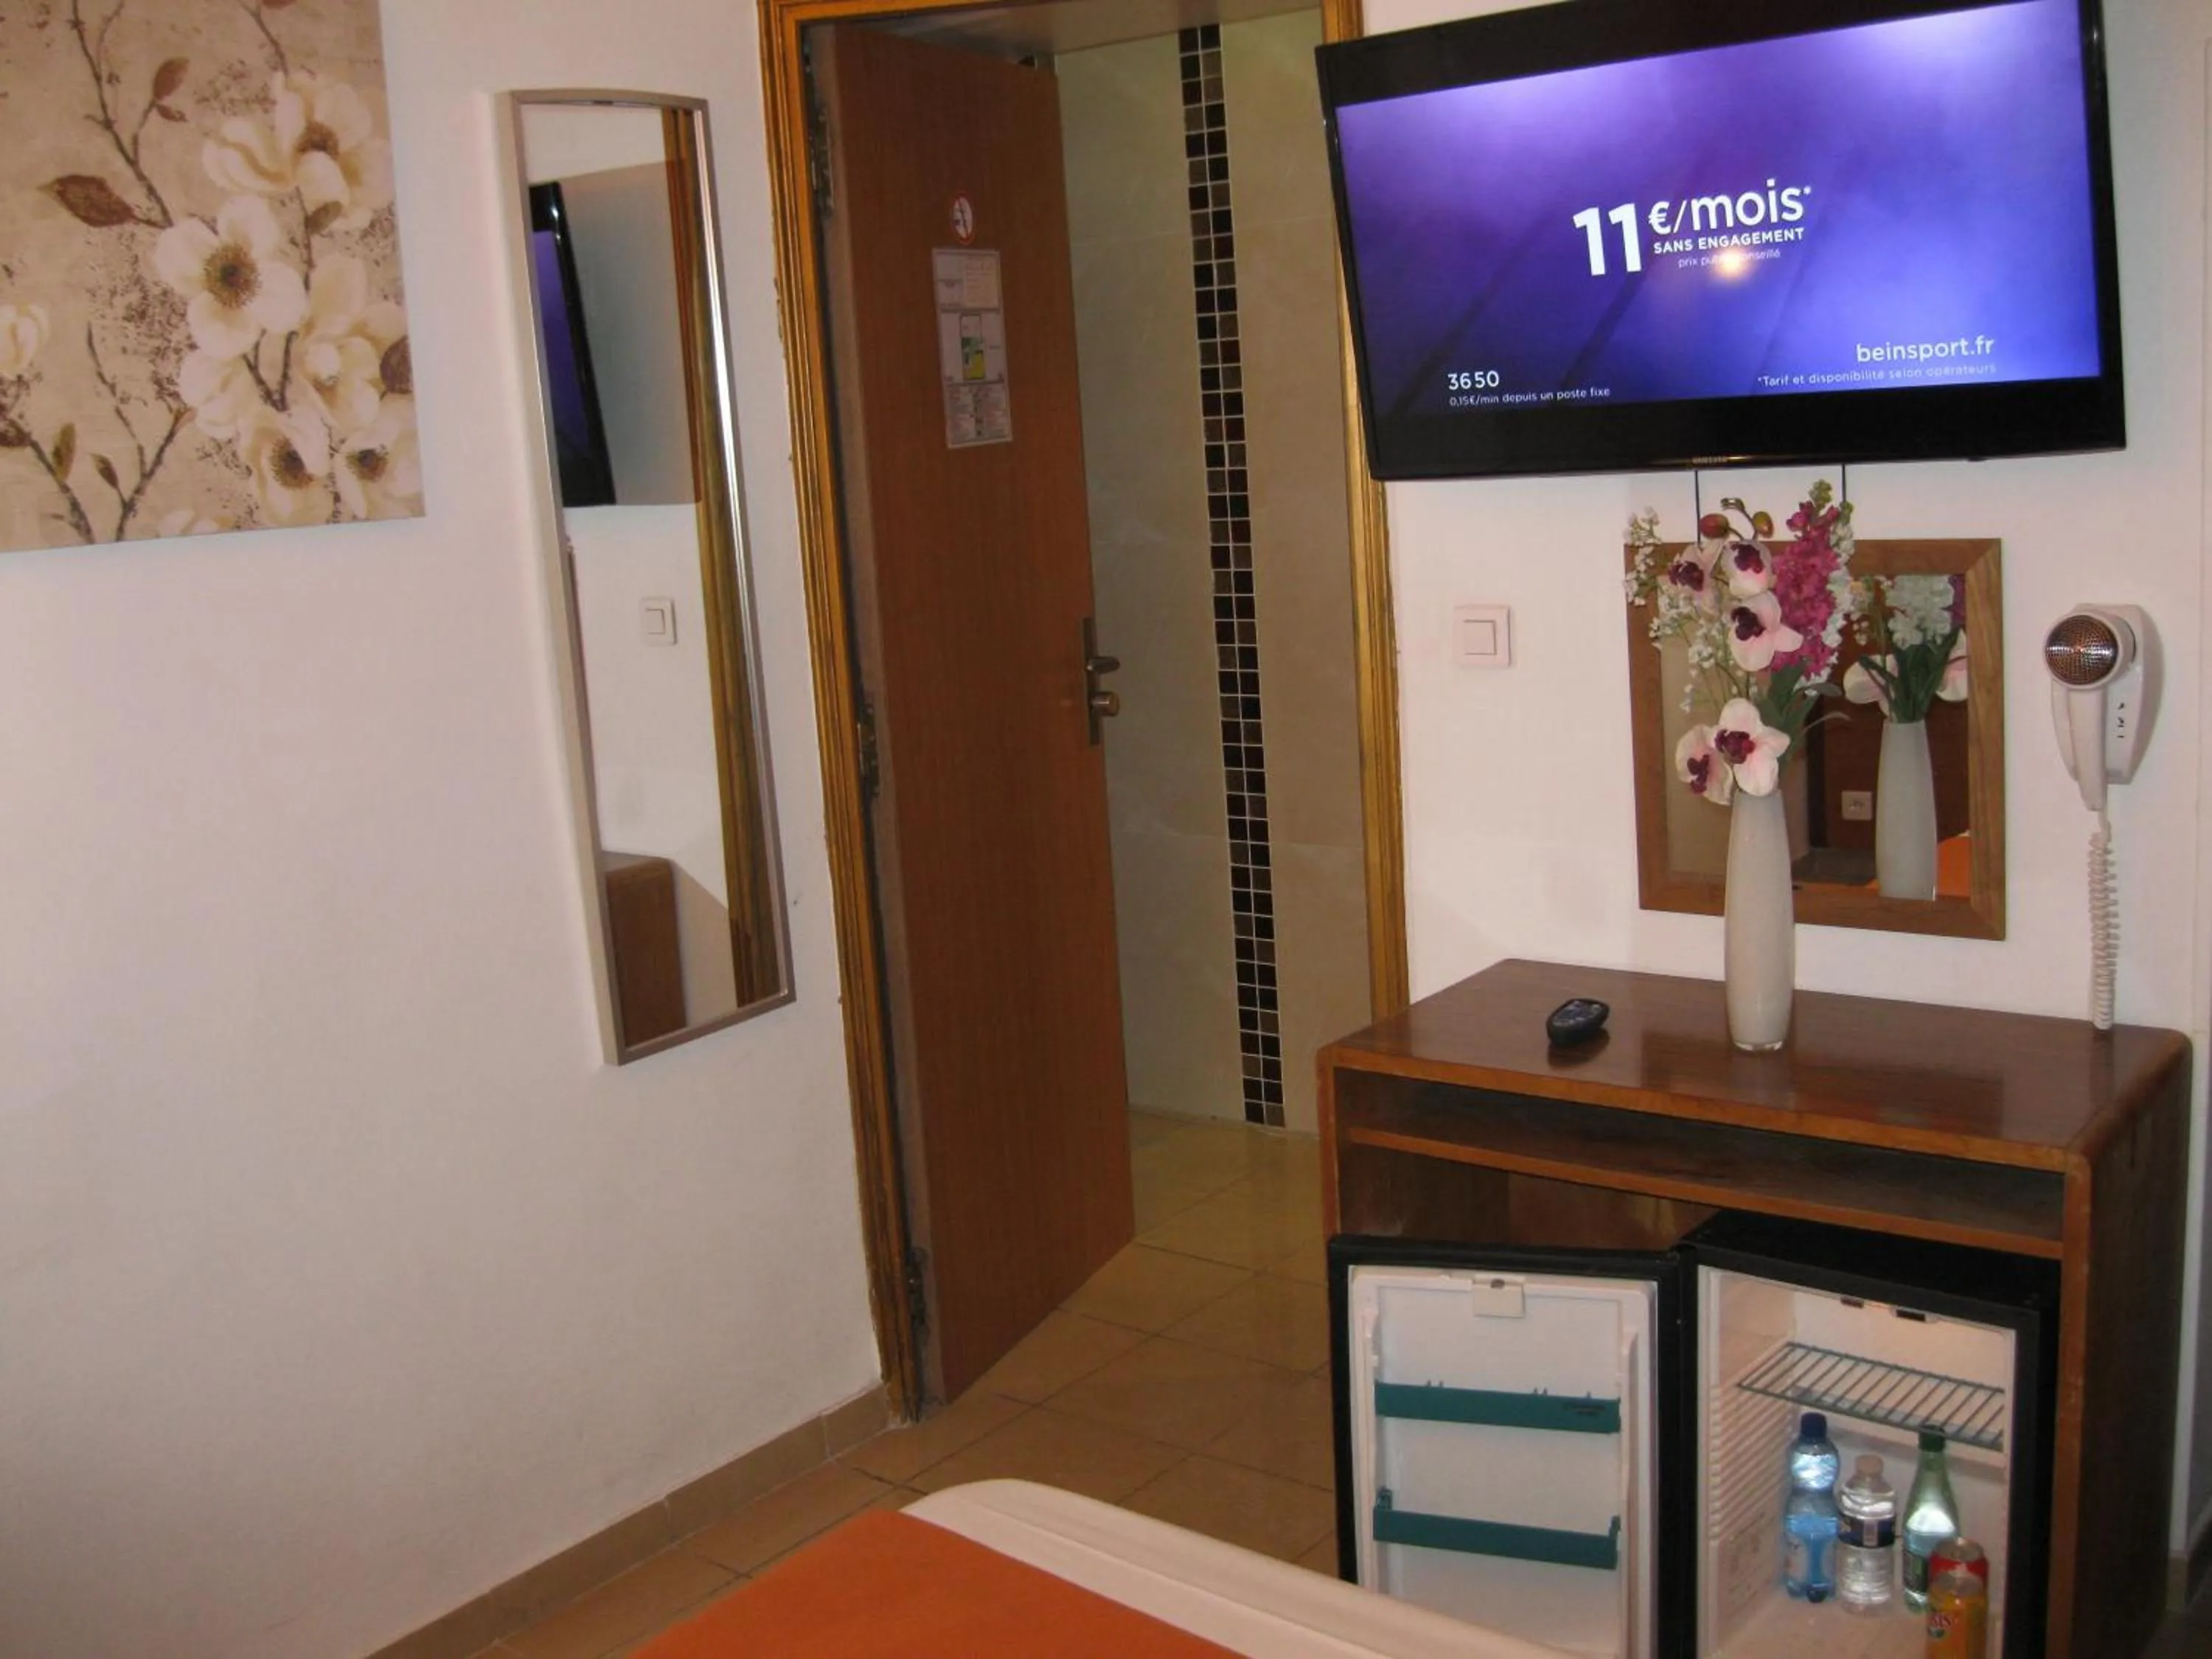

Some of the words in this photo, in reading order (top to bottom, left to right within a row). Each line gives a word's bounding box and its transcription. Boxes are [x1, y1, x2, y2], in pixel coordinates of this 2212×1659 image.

[1573, 202, 1642, 276] 11
[1653, 238, 1693, 254] SANS
[1698, 227, 1805, 250] ENGAGEMENT
[1678, 257, 1697, 268] prix
[1856, 335, 1995, 363] beinsport.fr
[1447, 370, 1500, 390] 3650
[1792, 375, 1804, 384] et
[1889, 368, 1922, 379] selon
[1502, 392, 1537, 403] depuis
[1540, 392, 1554, 400] un
[1557, 389, 1587, 401] poste
[1590, 386, 1610, 397] fixe
